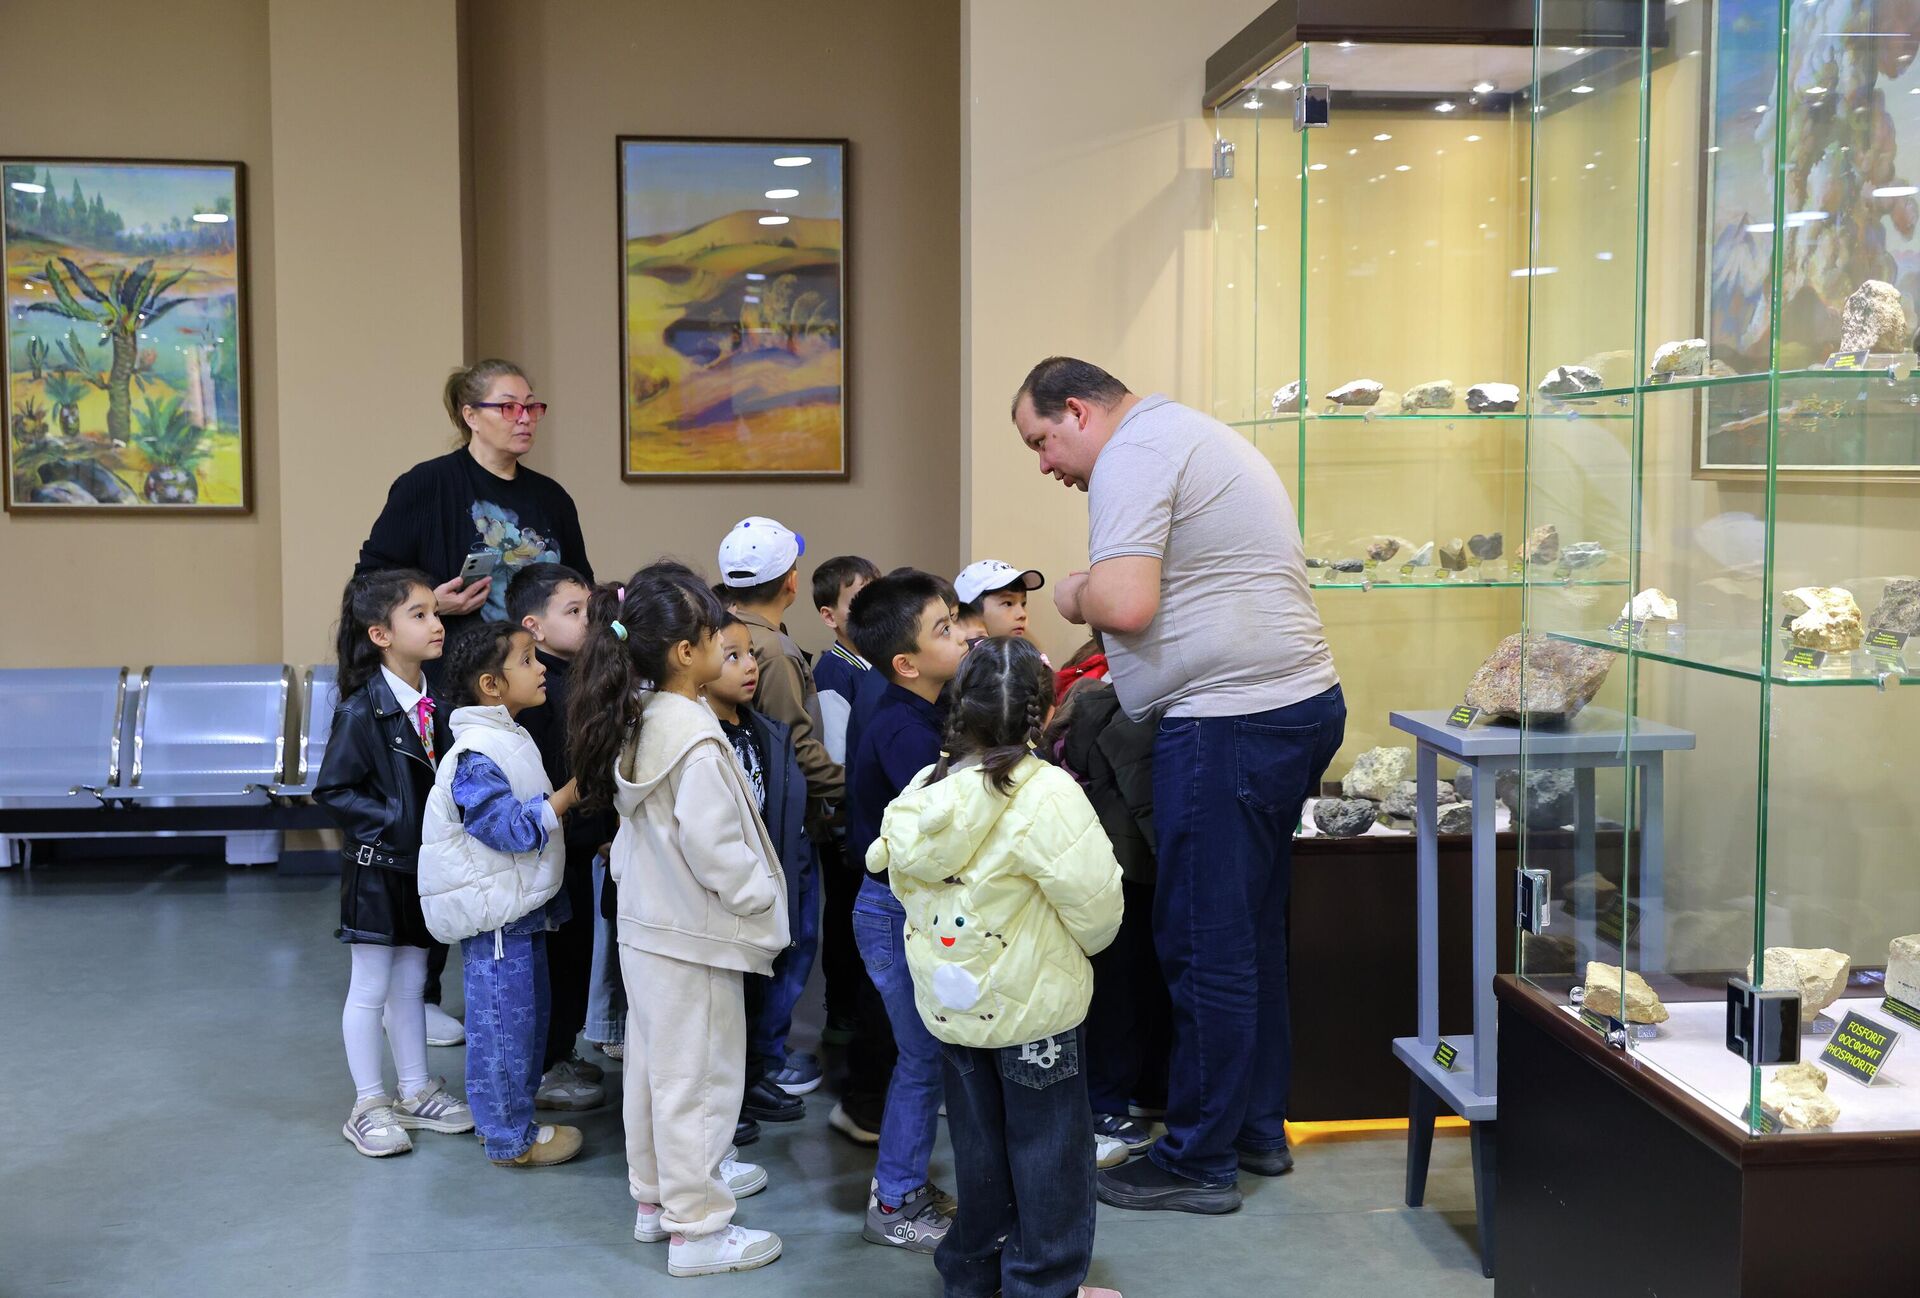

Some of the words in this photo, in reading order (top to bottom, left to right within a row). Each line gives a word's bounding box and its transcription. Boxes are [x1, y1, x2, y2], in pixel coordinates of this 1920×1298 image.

[1838, 1033, 1881, 1060] ФОСФОРИТ
[1847, 1021, 1887, 1046] FOSFORIT
[1826, 1043, 1878, 1077] PHOSPHORITE
[894, 1221, 917, 1242] alo
